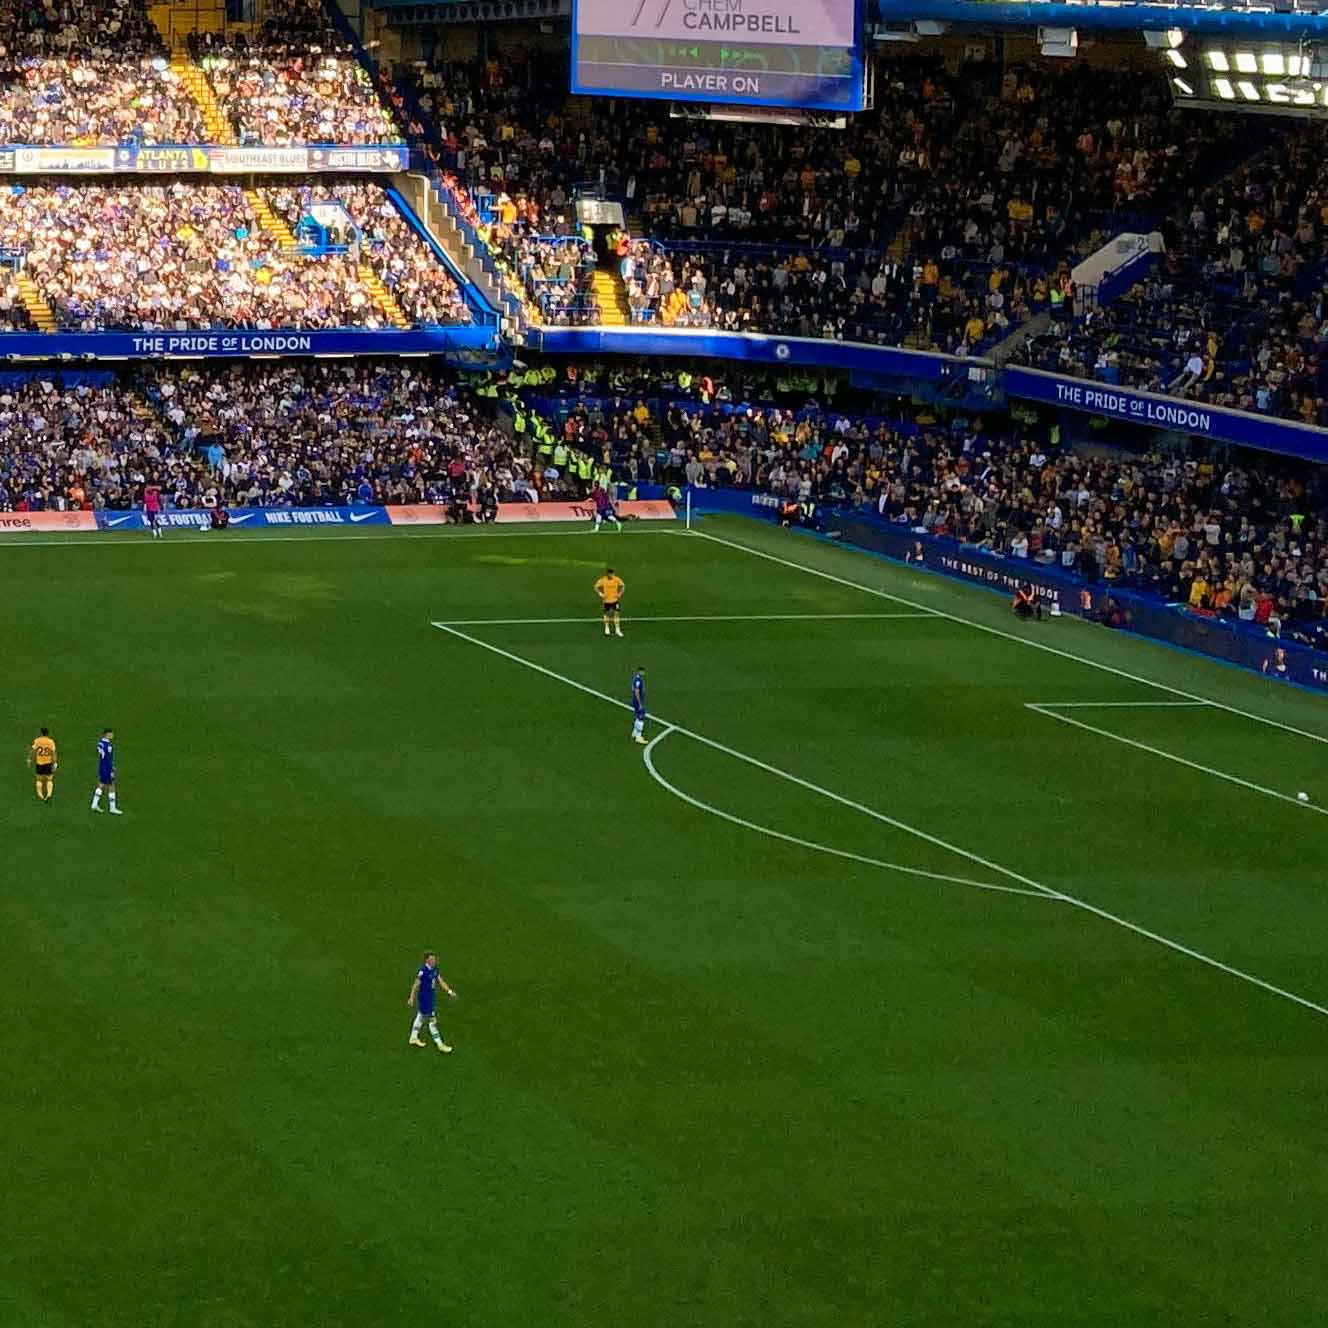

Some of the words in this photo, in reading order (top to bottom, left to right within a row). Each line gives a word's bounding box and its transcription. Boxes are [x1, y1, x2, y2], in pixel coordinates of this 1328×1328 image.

[683, 12, 801, 34] CAMPBELL
[661, 73, 728, 91] PLAYER
[732, 75, 760, 94] ON
[137, 151, 188, 161] ATLANTA
[133, 338, 164, 352] THE
[169, 337, 218, 352] PRIDE
[222, 337, 238, 349] OF
[241, 336, 311, 351] LONDON
[1056, 383, 1081, 403] THE
[1085, 391, 1127, 414] PRIDE
[1130, 399, 1145, 416] OF
[1147, 405, 1211, 431] LONDON
[265, 512, 290, 523] NIKE
[291, 510, 344, 523] FOOTBALL
[941, 557, 958, 569] THE
[961, 563, 984, 577] BEST
[987, 571, 999, 581] OF
[1003, 575, 1020, 589] THE
